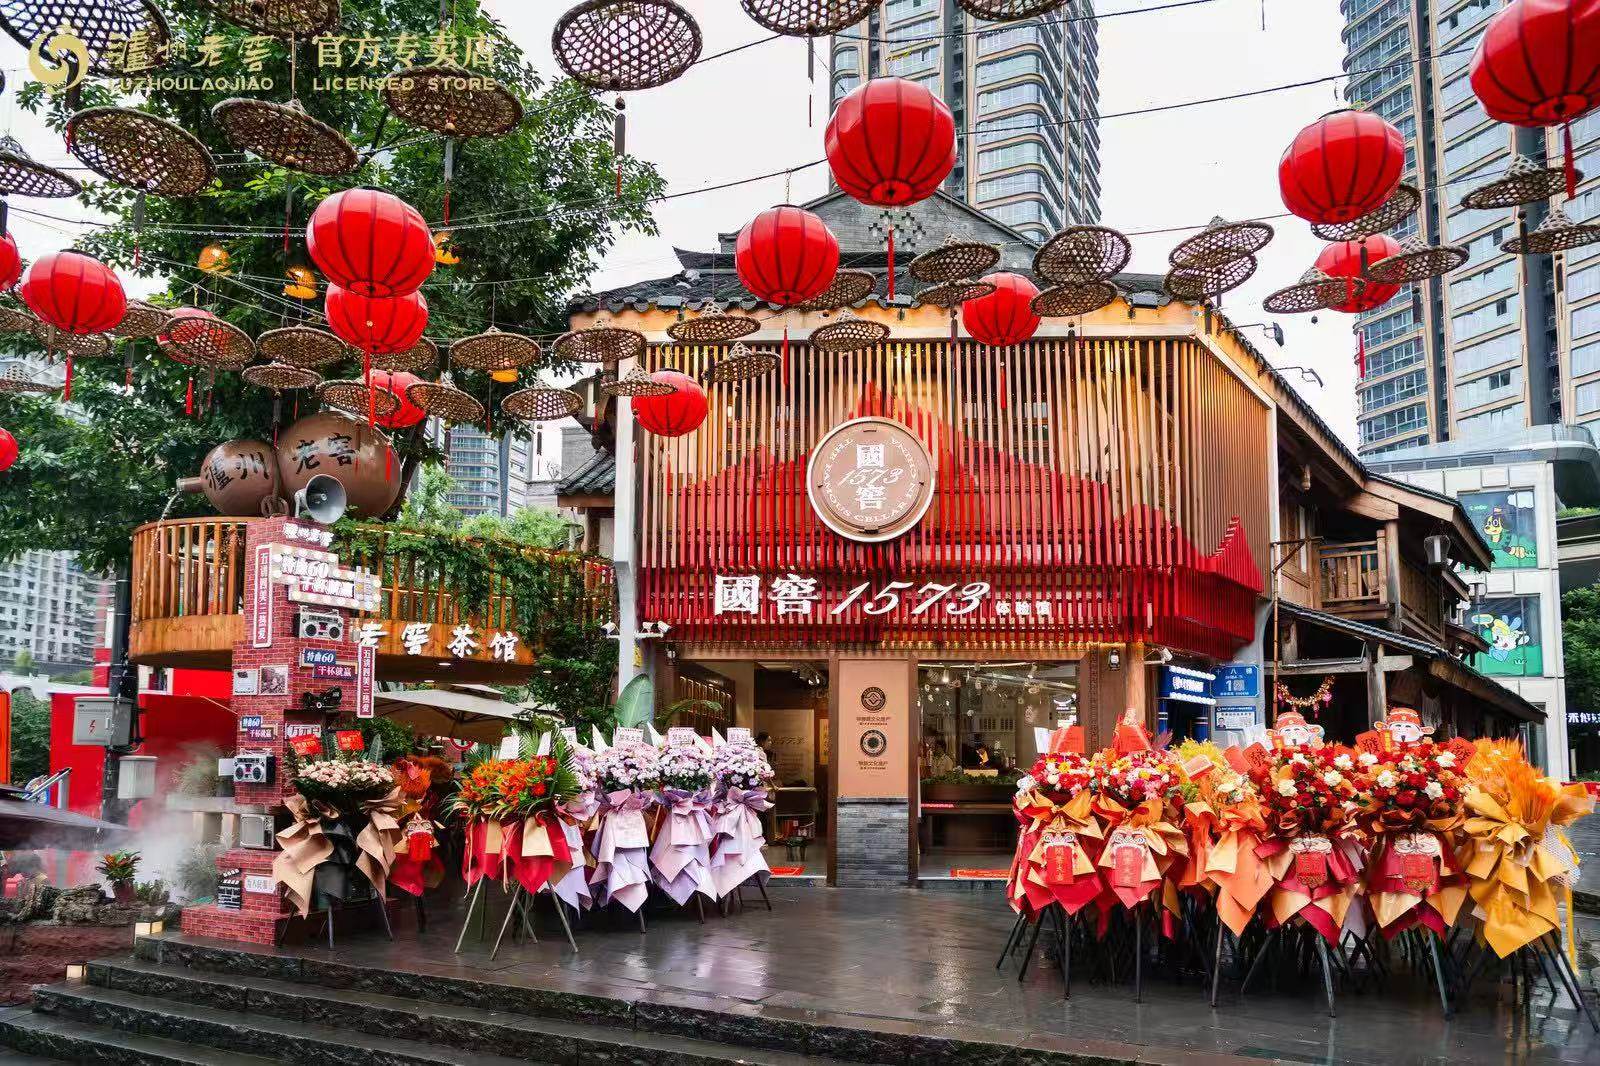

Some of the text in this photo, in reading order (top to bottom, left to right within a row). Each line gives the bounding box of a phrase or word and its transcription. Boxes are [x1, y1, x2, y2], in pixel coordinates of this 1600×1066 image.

[830, 437, 854, 461] THE
[890, 436, 918, 480] CHINA
[837, 468, 903, 487] 1573
[823, 463, 852, 518] FAMOUS
[854, 501, 908, 523] CELLAR
